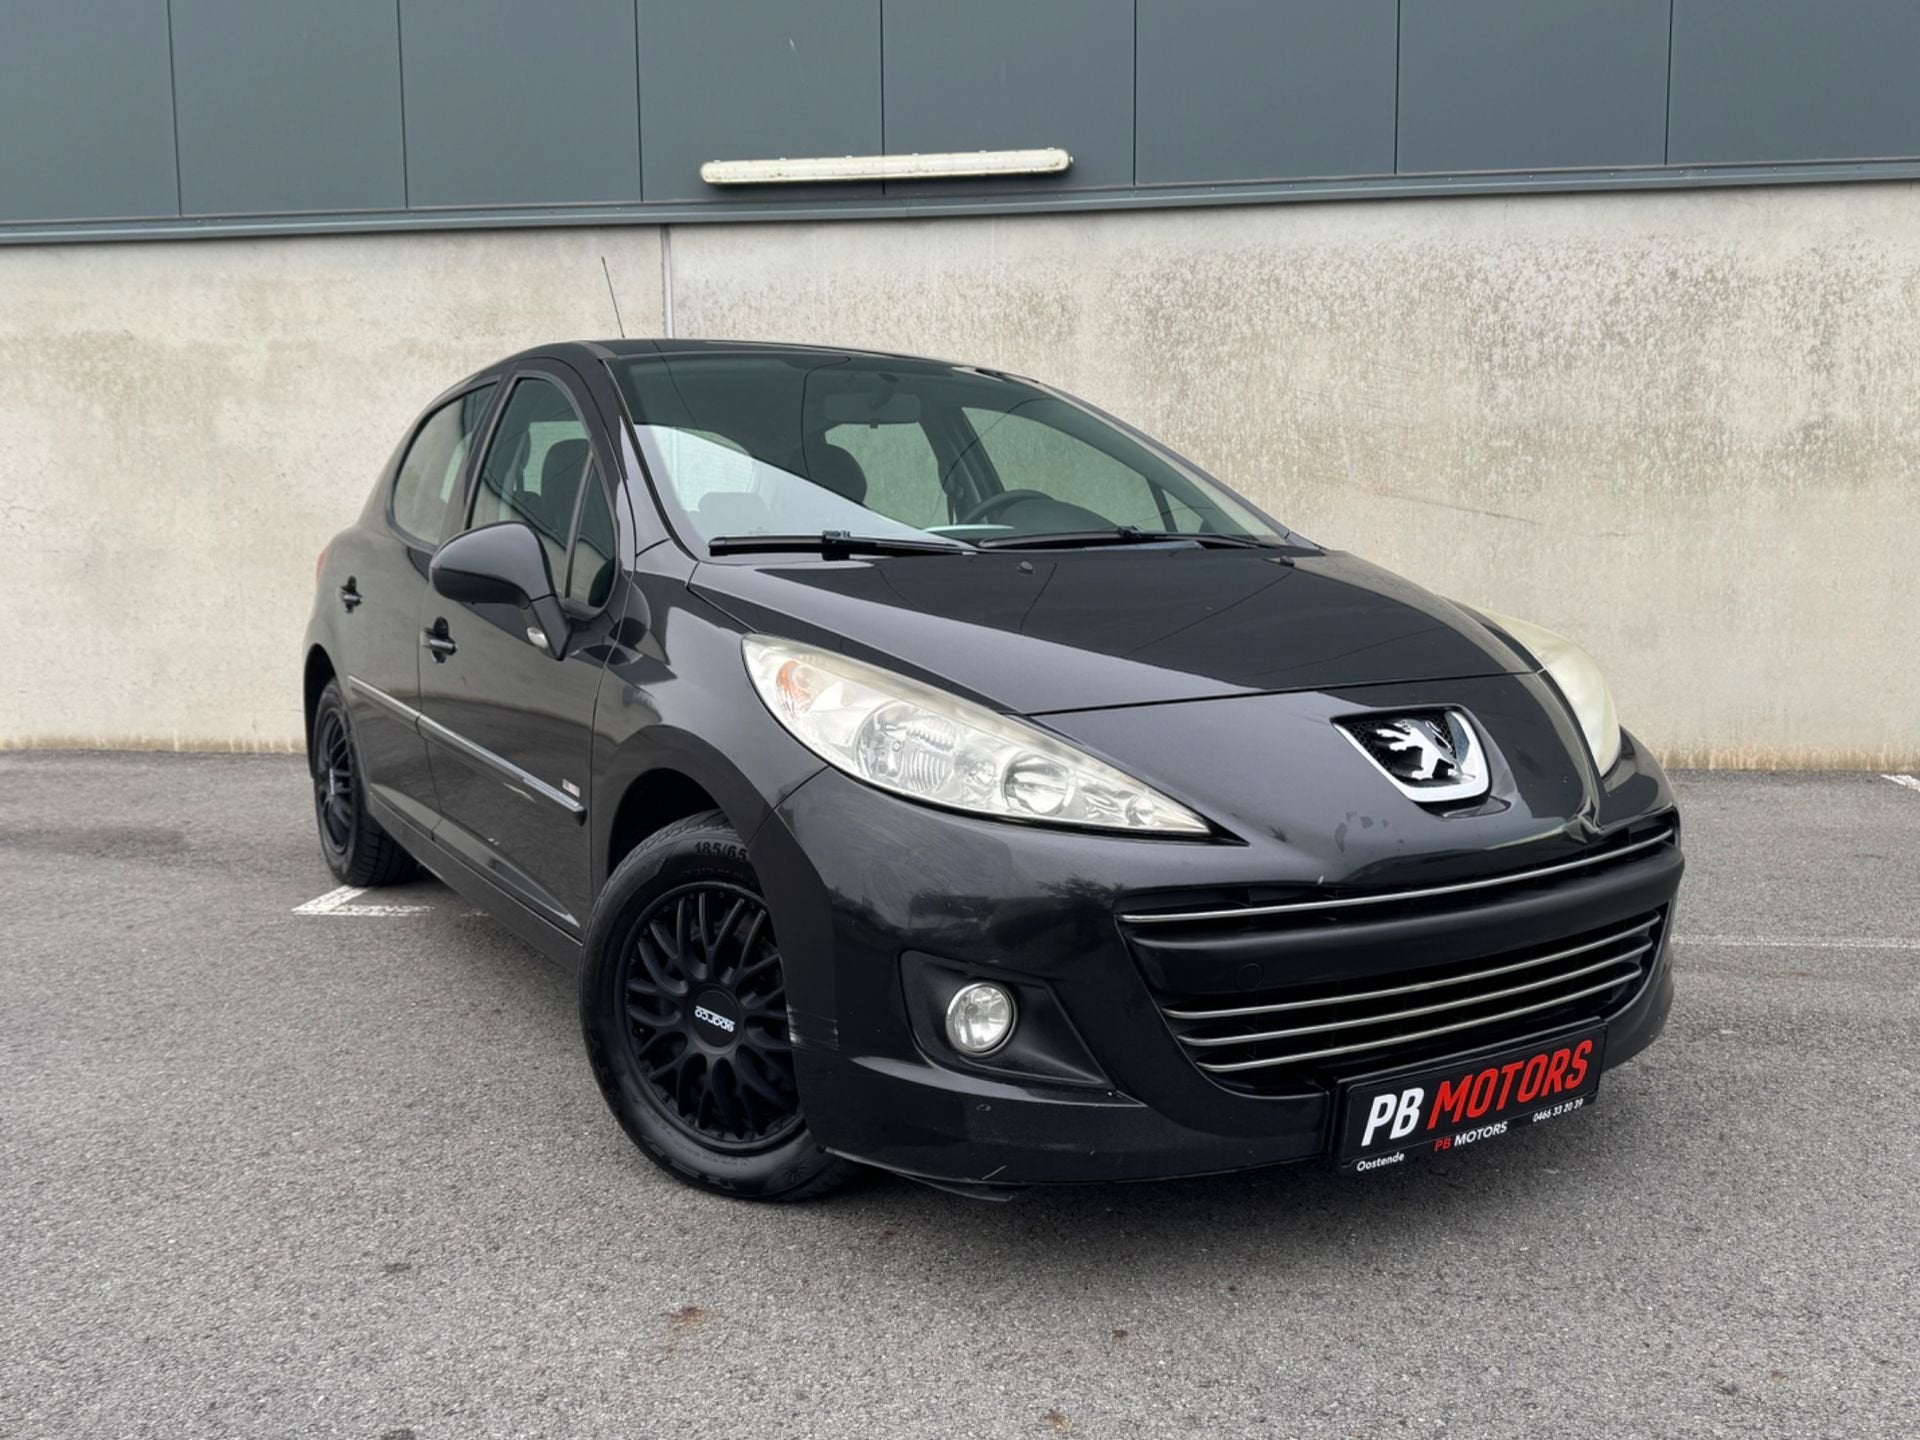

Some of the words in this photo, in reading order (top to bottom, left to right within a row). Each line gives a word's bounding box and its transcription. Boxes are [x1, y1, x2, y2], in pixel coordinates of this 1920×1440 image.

[695, 841, 748, 863] 185/65
[694, 1006, 735, 1033] sparco
[1361, 1087, 1425, 1147] PB
[1427, 1039, 1593, 1130] MOTORS
[1532, 1108, 1552, 1123] 0466
[1434, 1137, 1452, 1152] PB
[1454, 1121, 1508, 1147] MOTORS
[1356, 1152, 1405, 1172] Oostende
